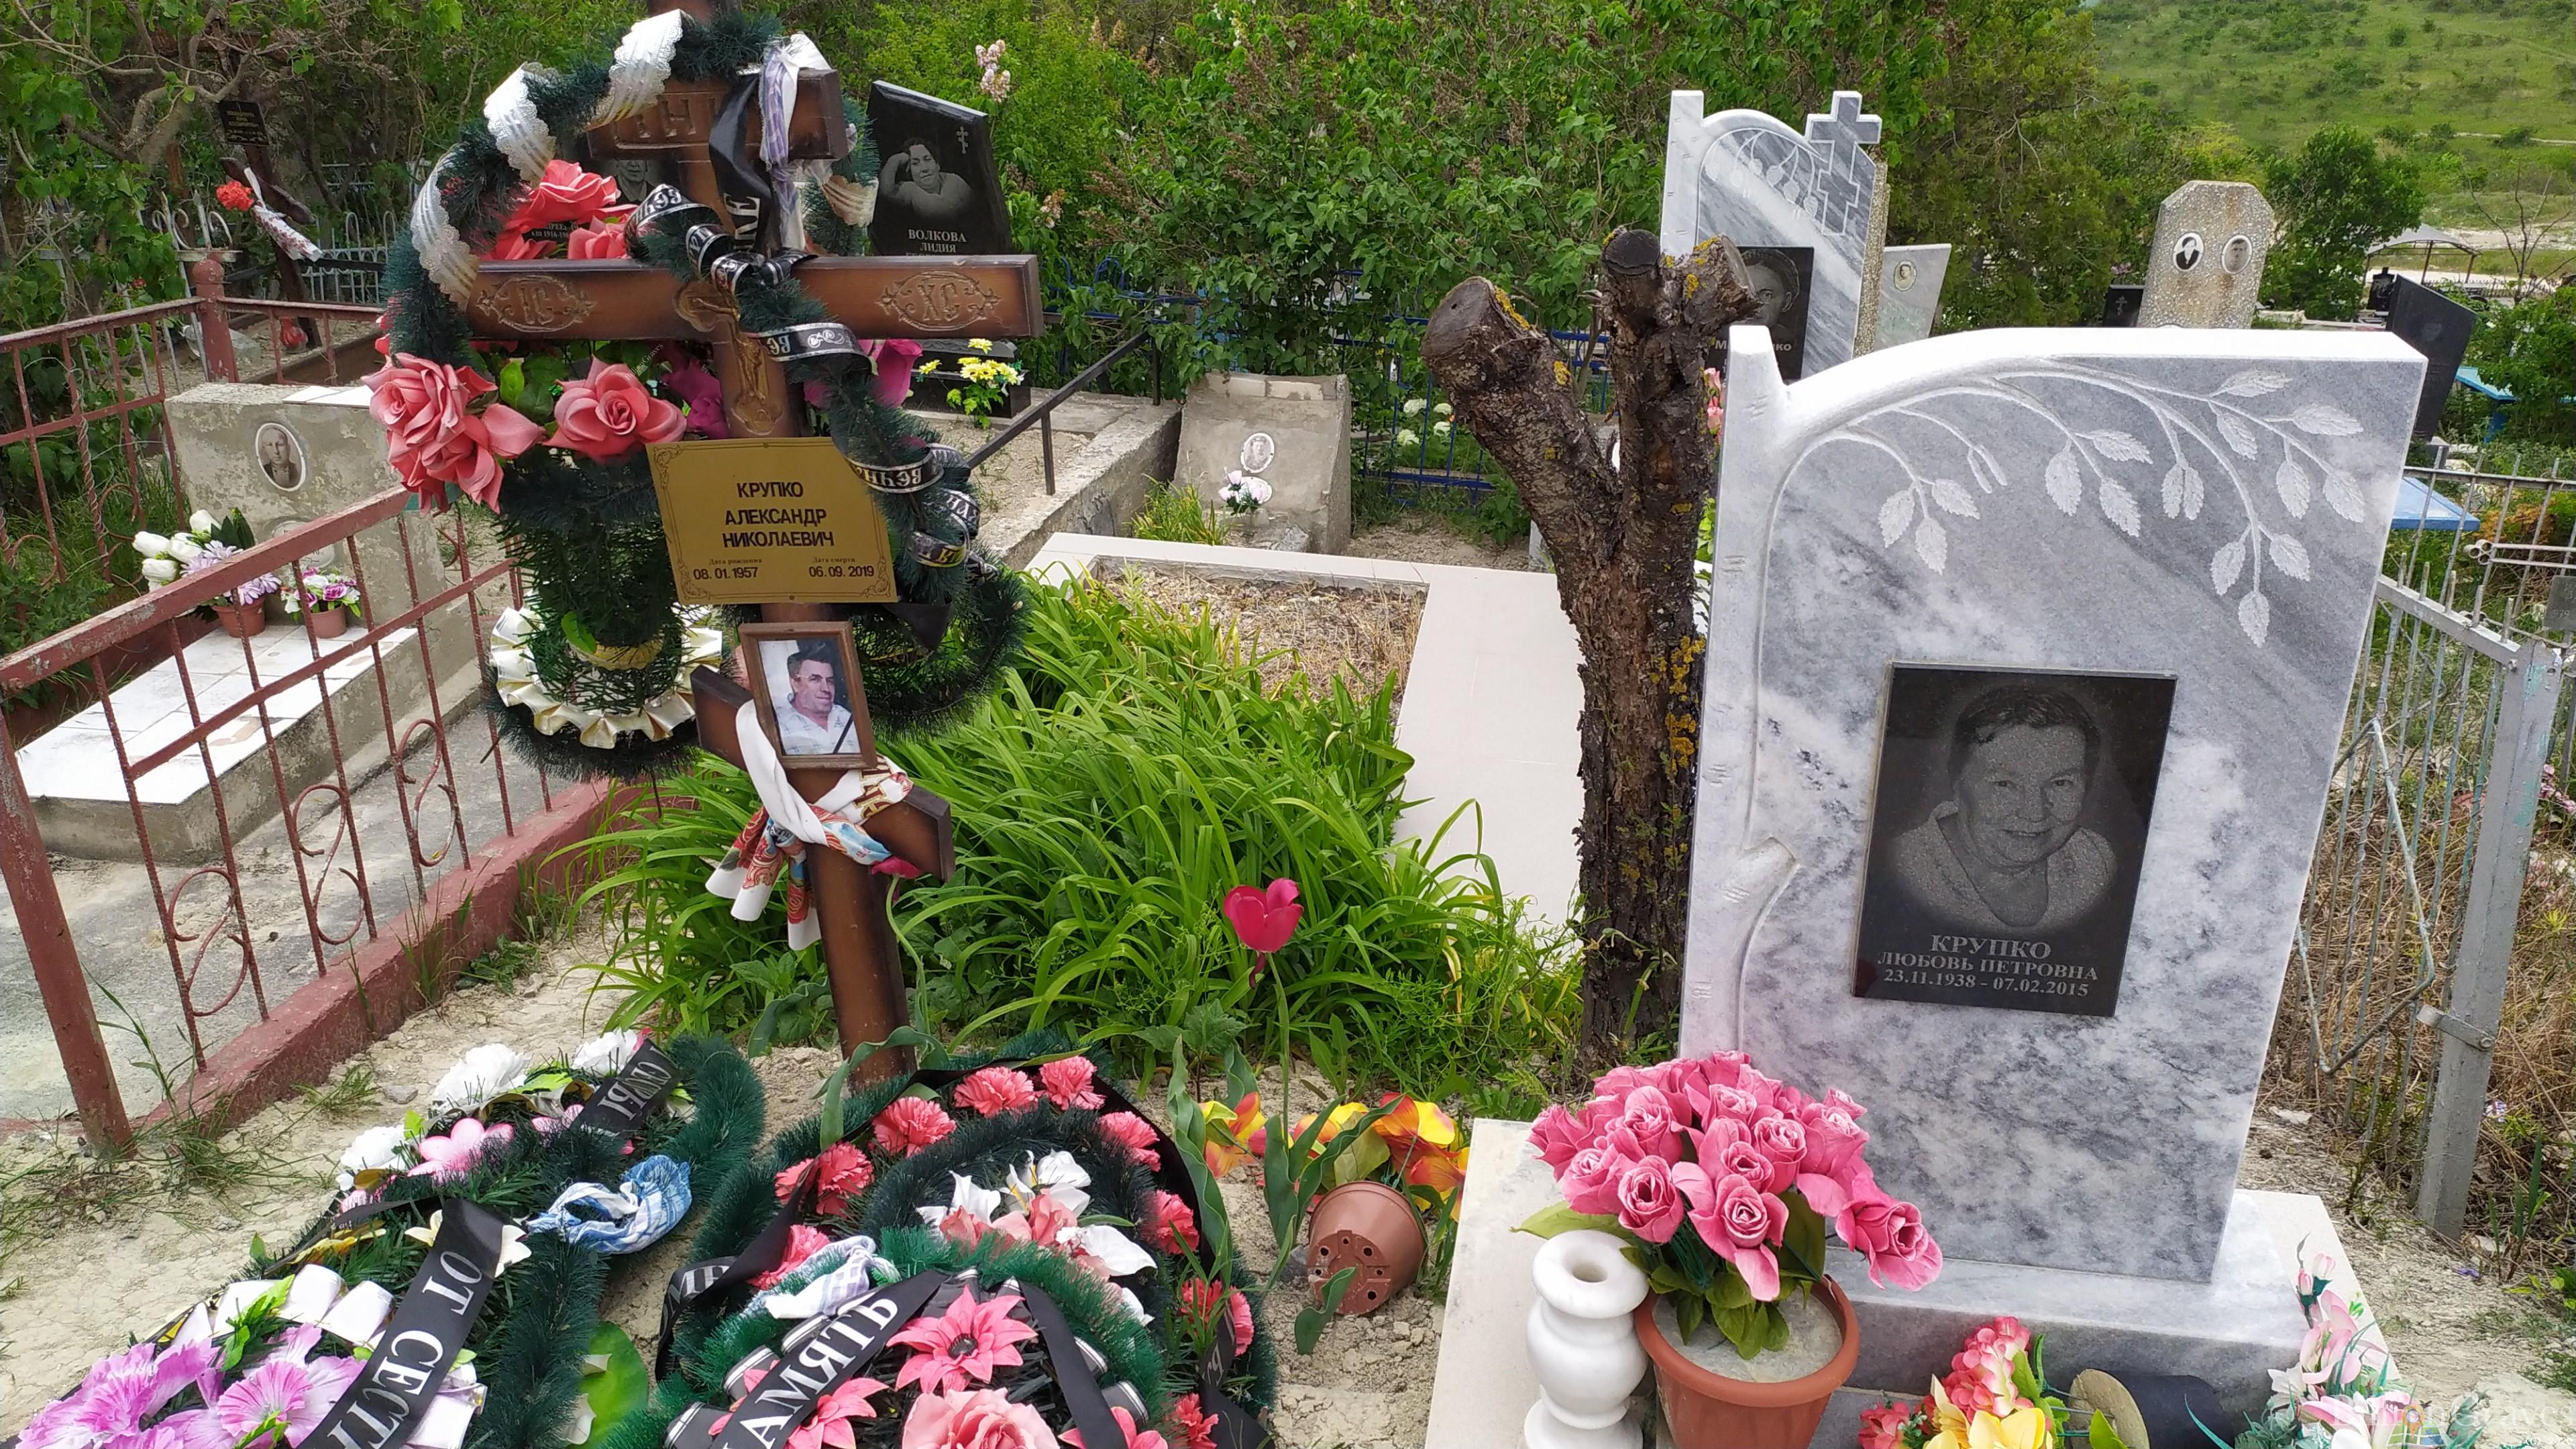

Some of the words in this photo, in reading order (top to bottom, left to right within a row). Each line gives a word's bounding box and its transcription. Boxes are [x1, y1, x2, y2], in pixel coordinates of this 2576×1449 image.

[908, 229, 967, 242] ВОЛКОВА
[920, 242, 957, 253] ЛИДИЯ
[737, 482, 804, 498] КРУПКО
[724, 508, 827, 527] АЛЕКСАНДР
[722, 531, 835, 548] НИКОЛАЕВИЧ
[708, 557, 727, 566] Дата
[1931, 934, 2052, 959] КРУПКО
[1878, 951, 1974, 971] ЛЮБОВЬ
[1980, 959, 2099, 981] ПЕТРОВНА
[1884, 969, 1976, 989] 23.11.1938
[1992, 978, 2089, 997] 07.02.2015
[422, 1251, 482, 1316] ОТ
[722, 1298, 898, 1449] АМЯТЬ
